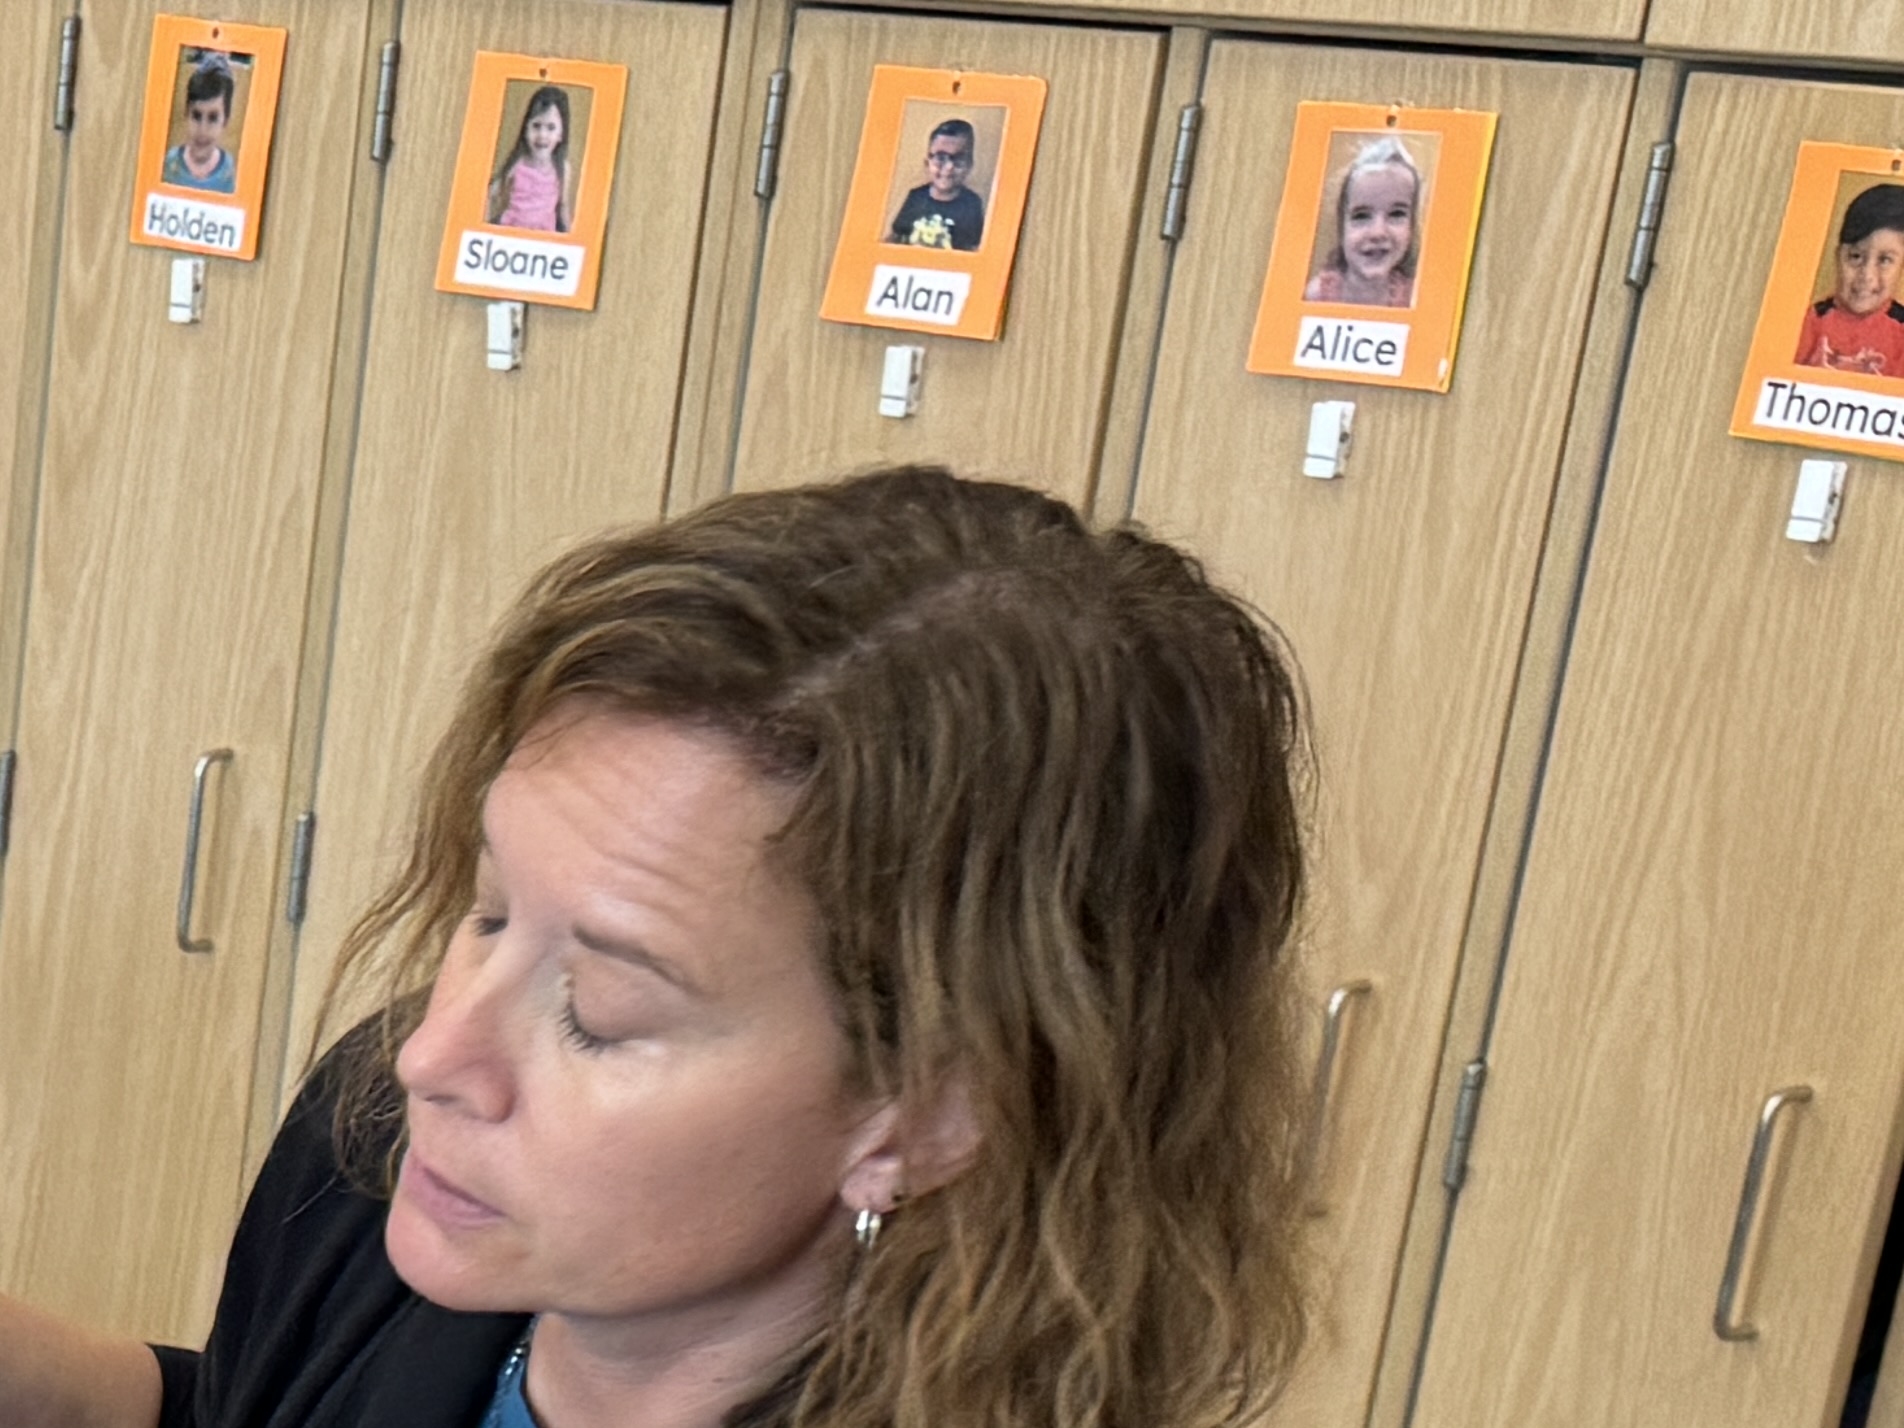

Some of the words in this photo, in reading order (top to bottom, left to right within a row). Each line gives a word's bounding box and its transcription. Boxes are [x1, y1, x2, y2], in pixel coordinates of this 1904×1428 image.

[148, 202, 235, 247] Holden
[464, 238, 569, 281] Sloane
[876, 276, 955, 316] Alan
[1300, 325, 1398, 367] Alice
